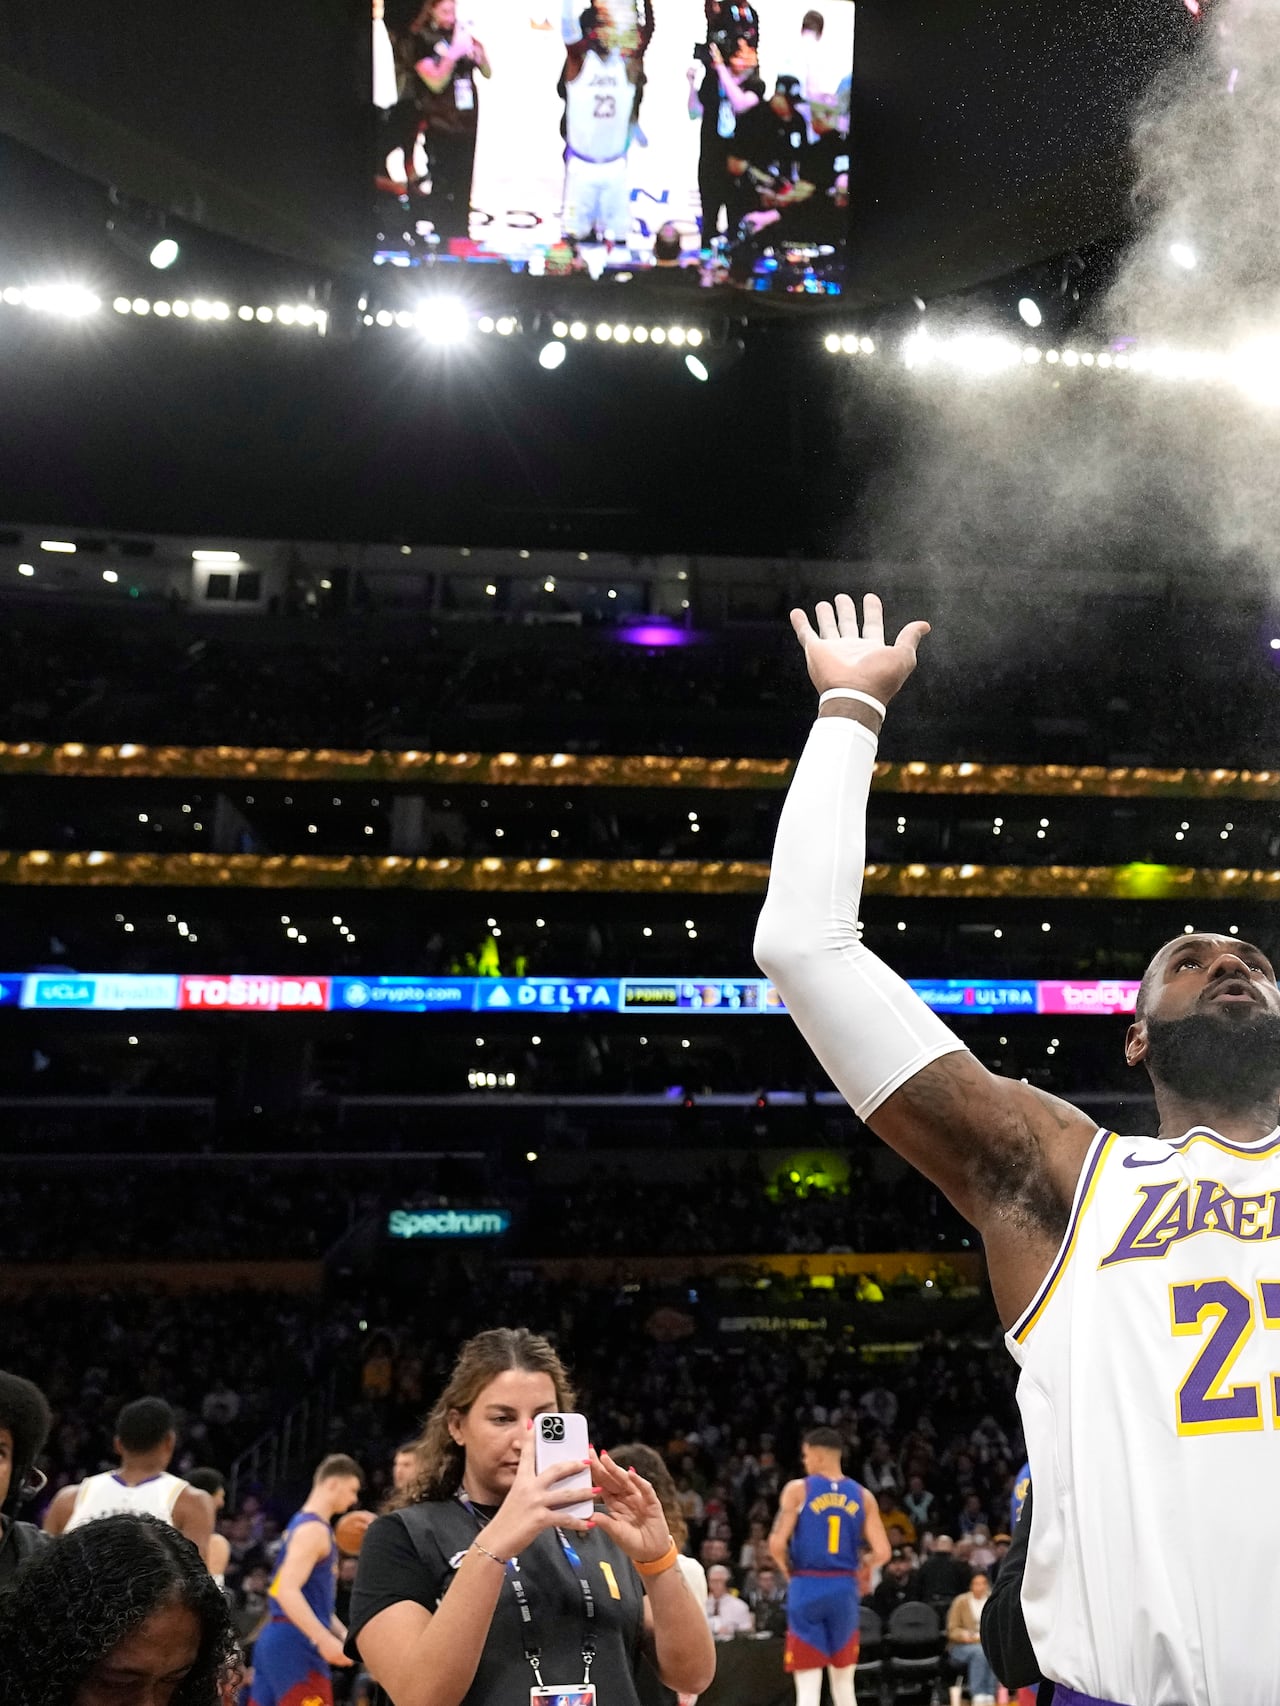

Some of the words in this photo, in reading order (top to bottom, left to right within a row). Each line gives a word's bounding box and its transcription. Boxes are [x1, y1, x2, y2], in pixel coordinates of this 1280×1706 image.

[593, 94, 617, 118] 23
[42, 983, 90, 1001] UCLA
[184, 980, 324, 1006] TOSHIBA
[371, 984, 461, 1004] crypto.com
[517, 985, 611, 1005] DELTA
[976, 988, 1033, 1005] ULTRA
[388, 1209, 502, 1239] Spectrum
[827, 1515, 841, 1554] 1
